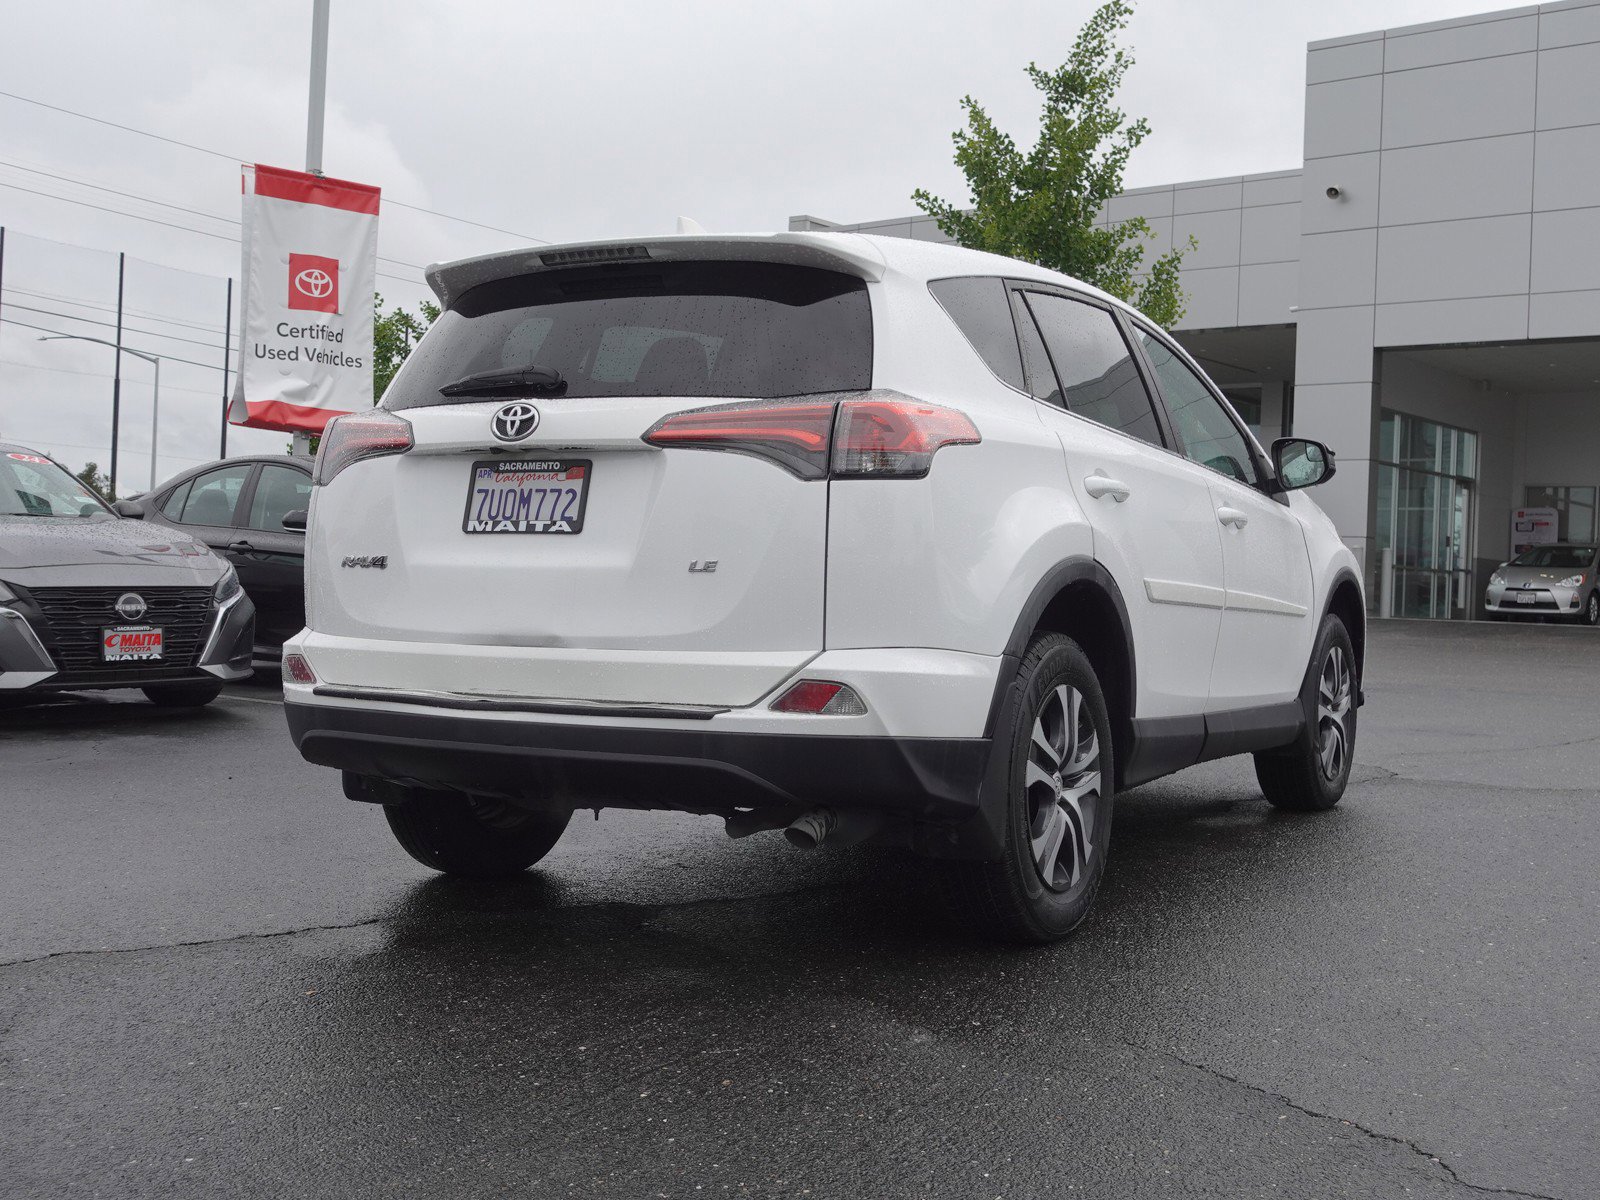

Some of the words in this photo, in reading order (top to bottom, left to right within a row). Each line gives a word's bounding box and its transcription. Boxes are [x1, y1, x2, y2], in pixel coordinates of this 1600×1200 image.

[276, 322, 344, 343] Certified
[255, 343, 299, 361] Used
[304, 347, 363, 368] Vehicles
[499, 461, 560, 470] SACRAMENTO
[478, 469, 493, 479] APR
[495, 471, 559, 487] California
[467, 520, 572, 532] MAITA
[341, 555, 388, 570] RAV4
[688, 559, 719, 573] LE
[120, 633, 161, 646] MAITA
[105, 653, 162, 661] MAITA
